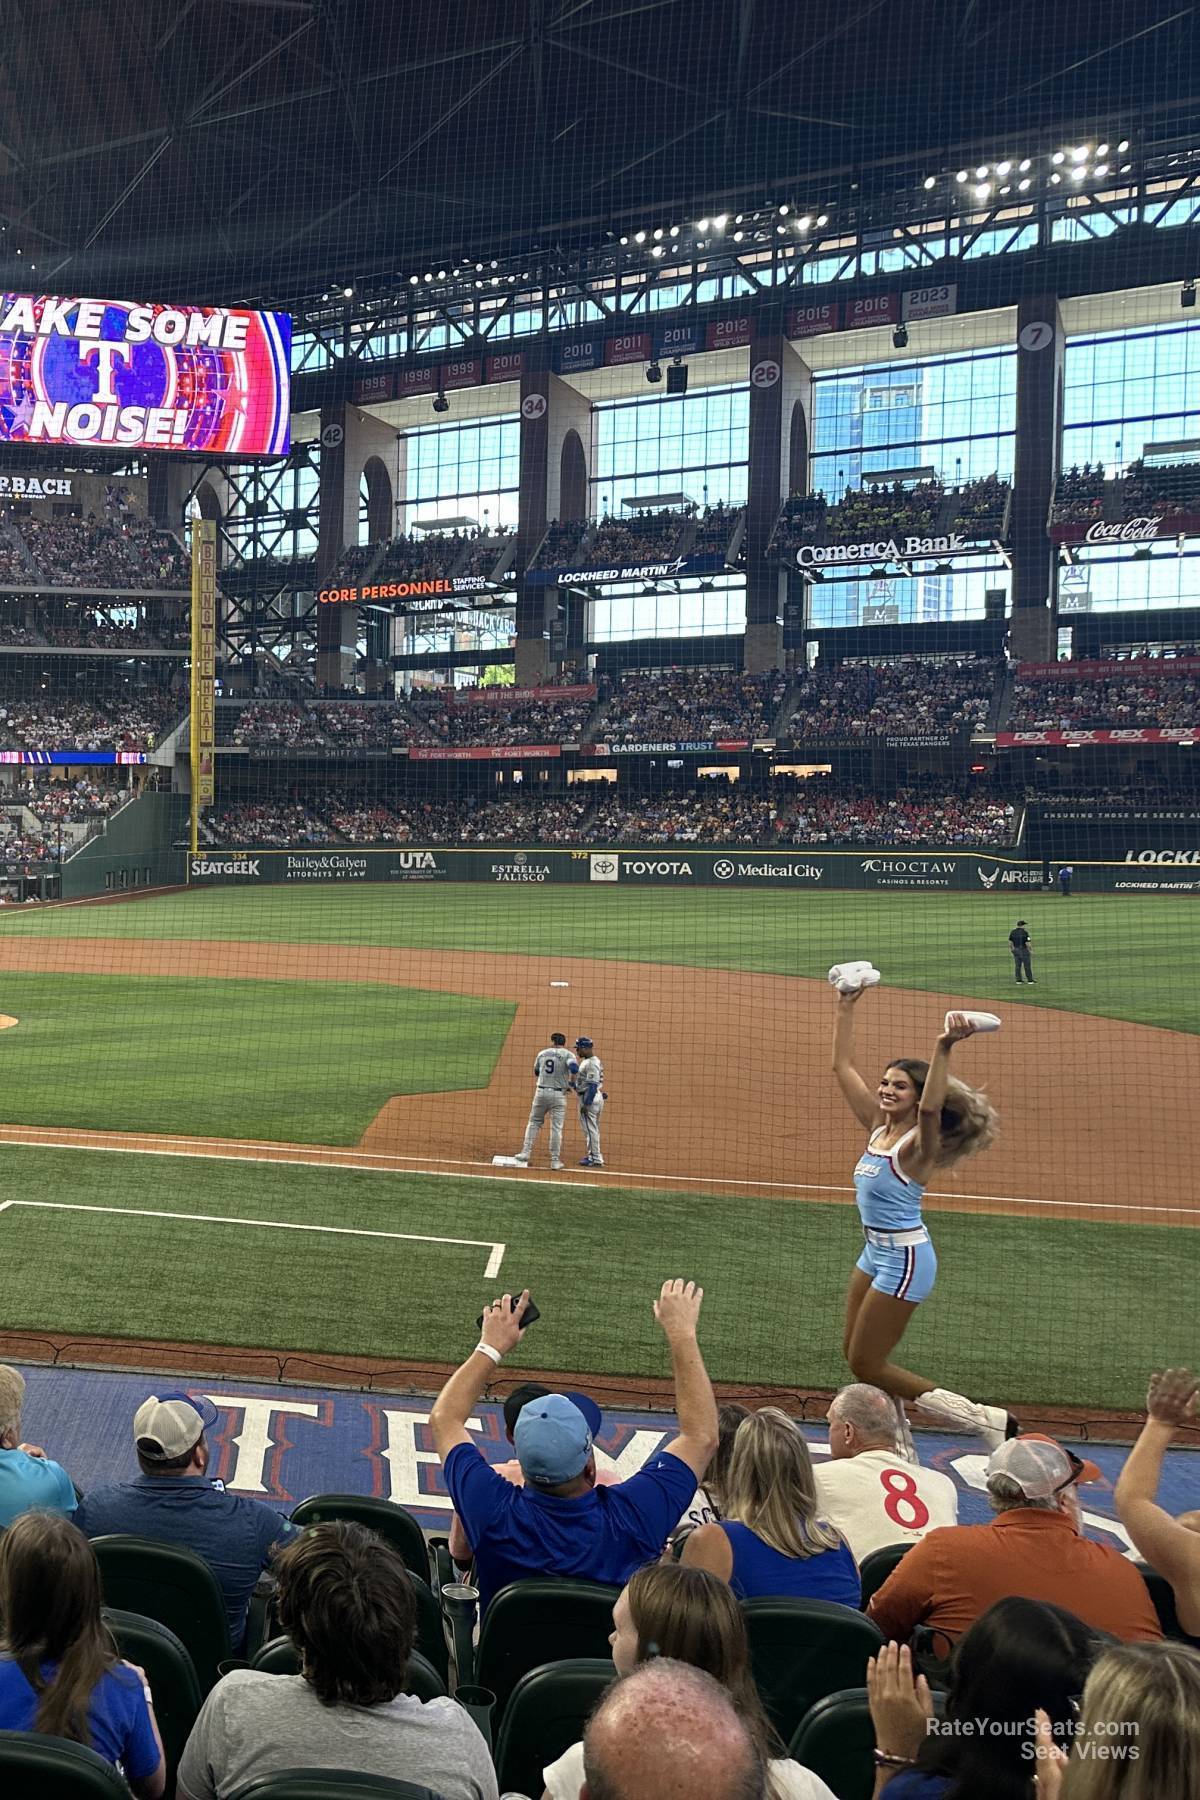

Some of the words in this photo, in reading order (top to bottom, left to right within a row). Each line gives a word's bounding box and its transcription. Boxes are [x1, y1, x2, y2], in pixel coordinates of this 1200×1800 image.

[910, 287, 949, 305] 2023
[854, 297, 889, 314] 2016
[797, 306, 830, 322] 2015
[125, 307, 250, 349] SOME
[716, 319, 748, 335] 2012
[615, 336, 641, 350] 2011
[665, 328, 691, 343] 2011
[1031, 327, 1043, 345] 7
[564, 343, 592, 358] 2010
[448, 362, 474, 376] 1999
[493, 354, 521, 369] 2010
[79, 340, 130, 403] T
[404, 369, 431, 384] 1998
[754, 366, 777, 382] 26
[362, 376, 386, 389] 1996
[524, 398, 545, 414] 34
[28, 401, 188, 444] NOISE!
[324, 429, 341, 443] 42
[1086, 517, 1163, 542] Coca-Cola
[904, 533, 965, 555] Bank
[453, 576, 486, 585] STAFFING
[558, 569, 619, 583] LOCKHEED
[621, 565, 668, 578] MARTIN
[203, 545, 212, 623] BRING
[319, 588, 357, 603] CORE
[362, 579, 452, 599] PERSONNEL
[454, 582, 486, 591] SERVICES
[203, 629, 211, 675] THE
[515, 689, 535, 699] BUDS
[202, 679, 211, 742] HEAT
[1014, 732, 1047, 740] DEX
[1061, 731, 1095, 739] DEX
[1109, 729, 1145, 738] DEX
[1159, 728, 1196, 738] DEX
[612, 743, 676, 753] GARDENERS
[680, 741, 713, 750] TRUST
[400, 852, 436, 868] UTA
[870, 860, 956, 872] CHOCTAW
[192, 860, 260, 876] SEATGEEK
[491, 865, 550, 874] ESTRELLA
[623, 861, 693, 875] TOYOTA
[738, 863, 792, 877] Medical
[794, 864, 823, 880] City
[496, 873, 545, 881] JALISCO
[1001, 870, 1022, 883] AIR
[545, 1059, 555, 1074] 9
[880, 1469, 929, 1529] 8
